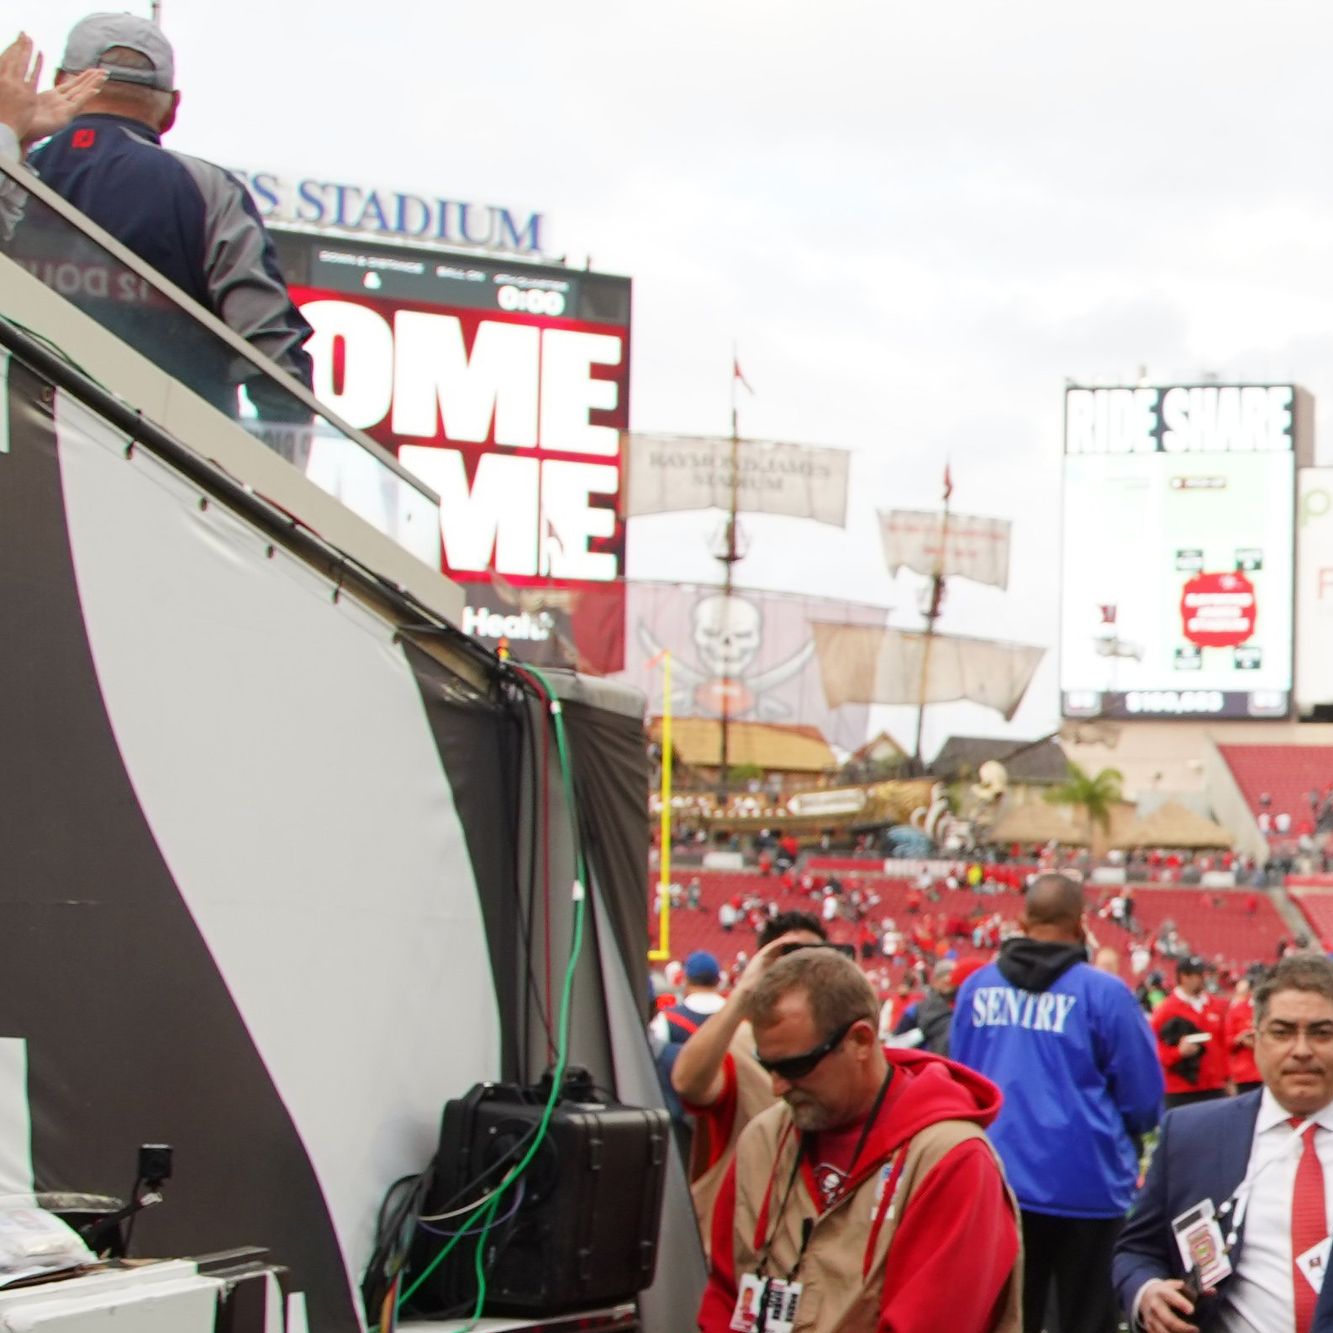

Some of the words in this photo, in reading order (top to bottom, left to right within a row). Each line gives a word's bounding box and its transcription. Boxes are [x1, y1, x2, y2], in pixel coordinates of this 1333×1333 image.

[297, 179, 543, 252] STADIUM
[1066, 386, 1158, 453] RIDE
[1161, 384, 1293, 451] SHARE
[972, 986, 1077, 1034] SENTRY
